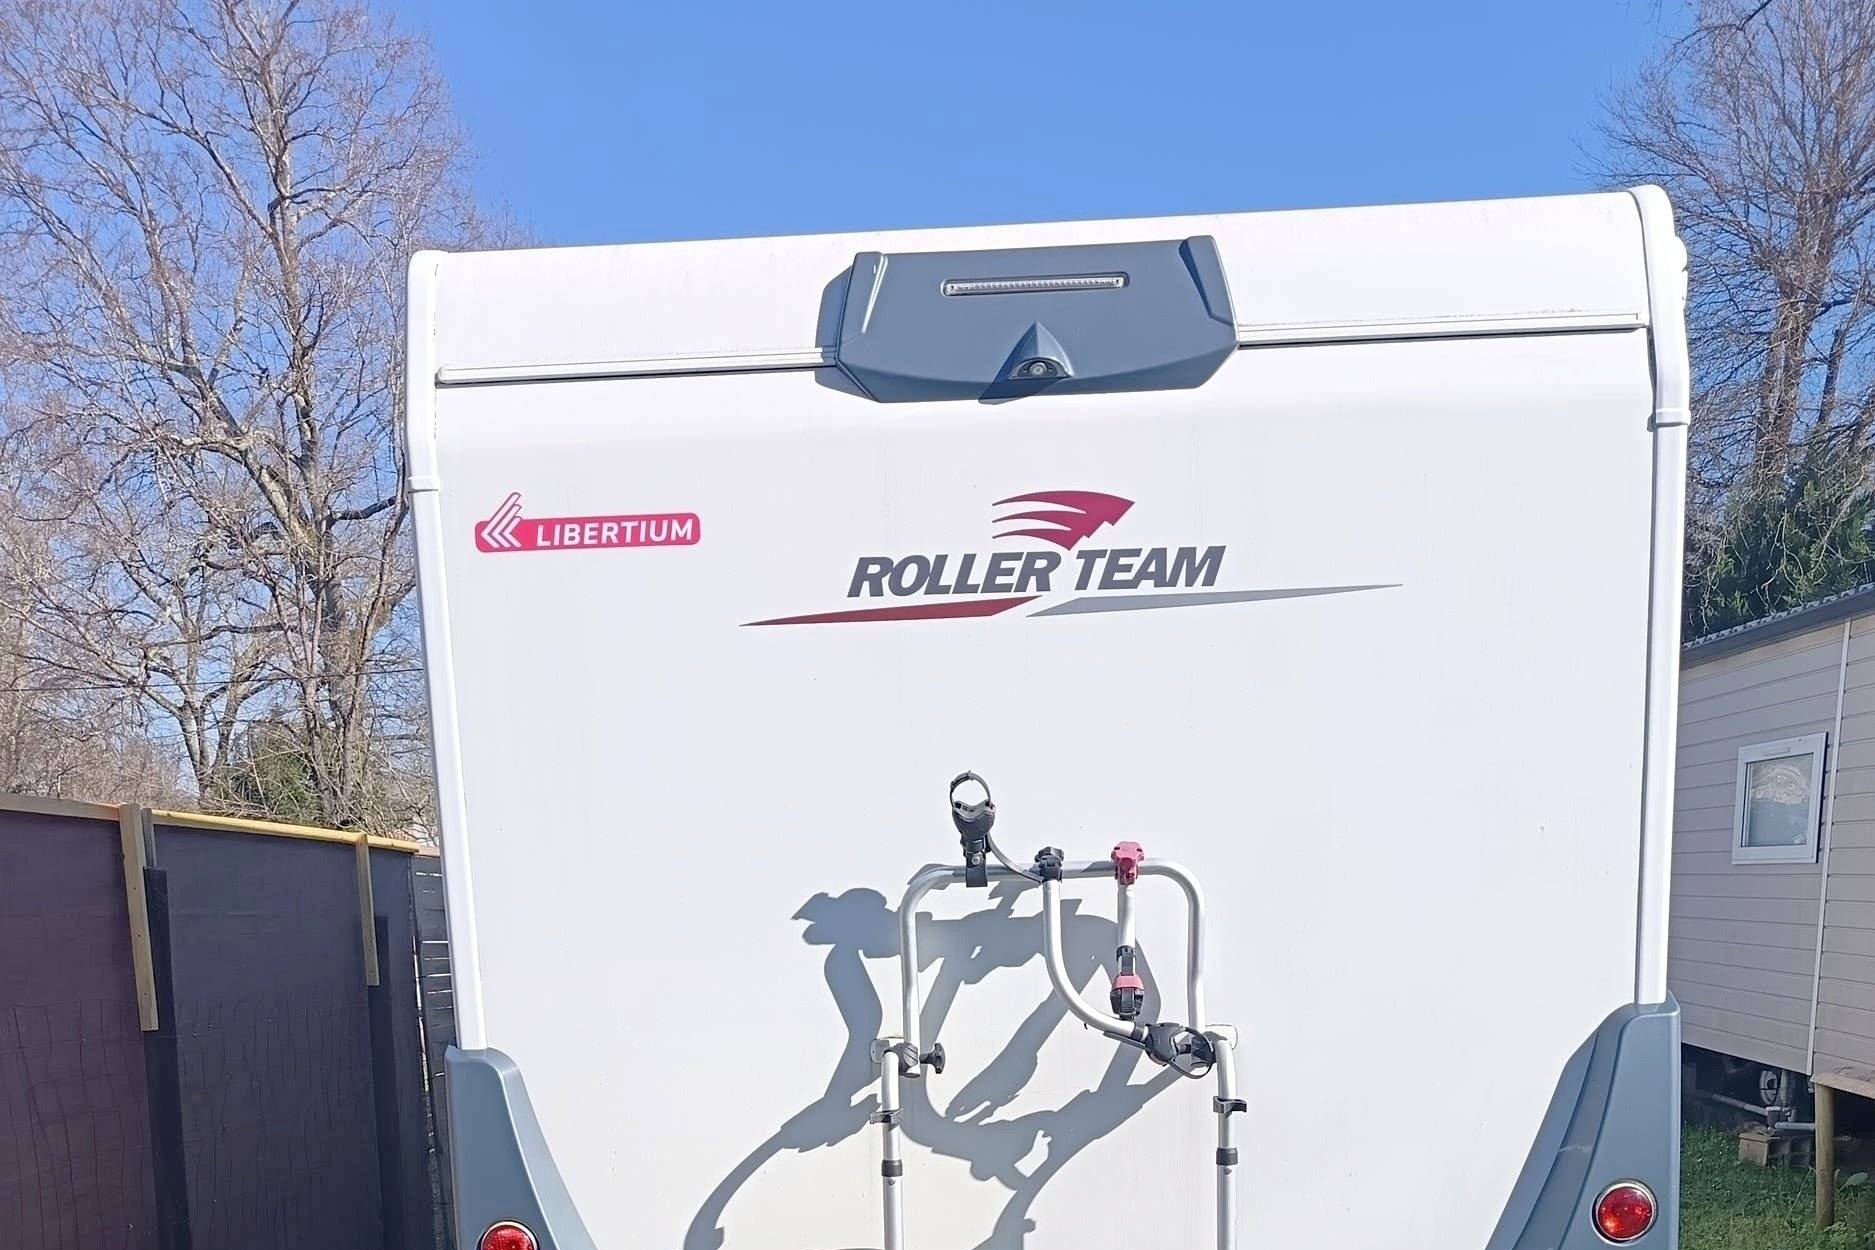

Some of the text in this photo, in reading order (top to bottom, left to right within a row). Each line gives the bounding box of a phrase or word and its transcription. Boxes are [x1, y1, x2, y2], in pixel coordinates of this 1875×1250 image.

[536, 519, 693, 547] LIBERTIUM
[847, 545, 1226, 598] ROLLER TEAM
